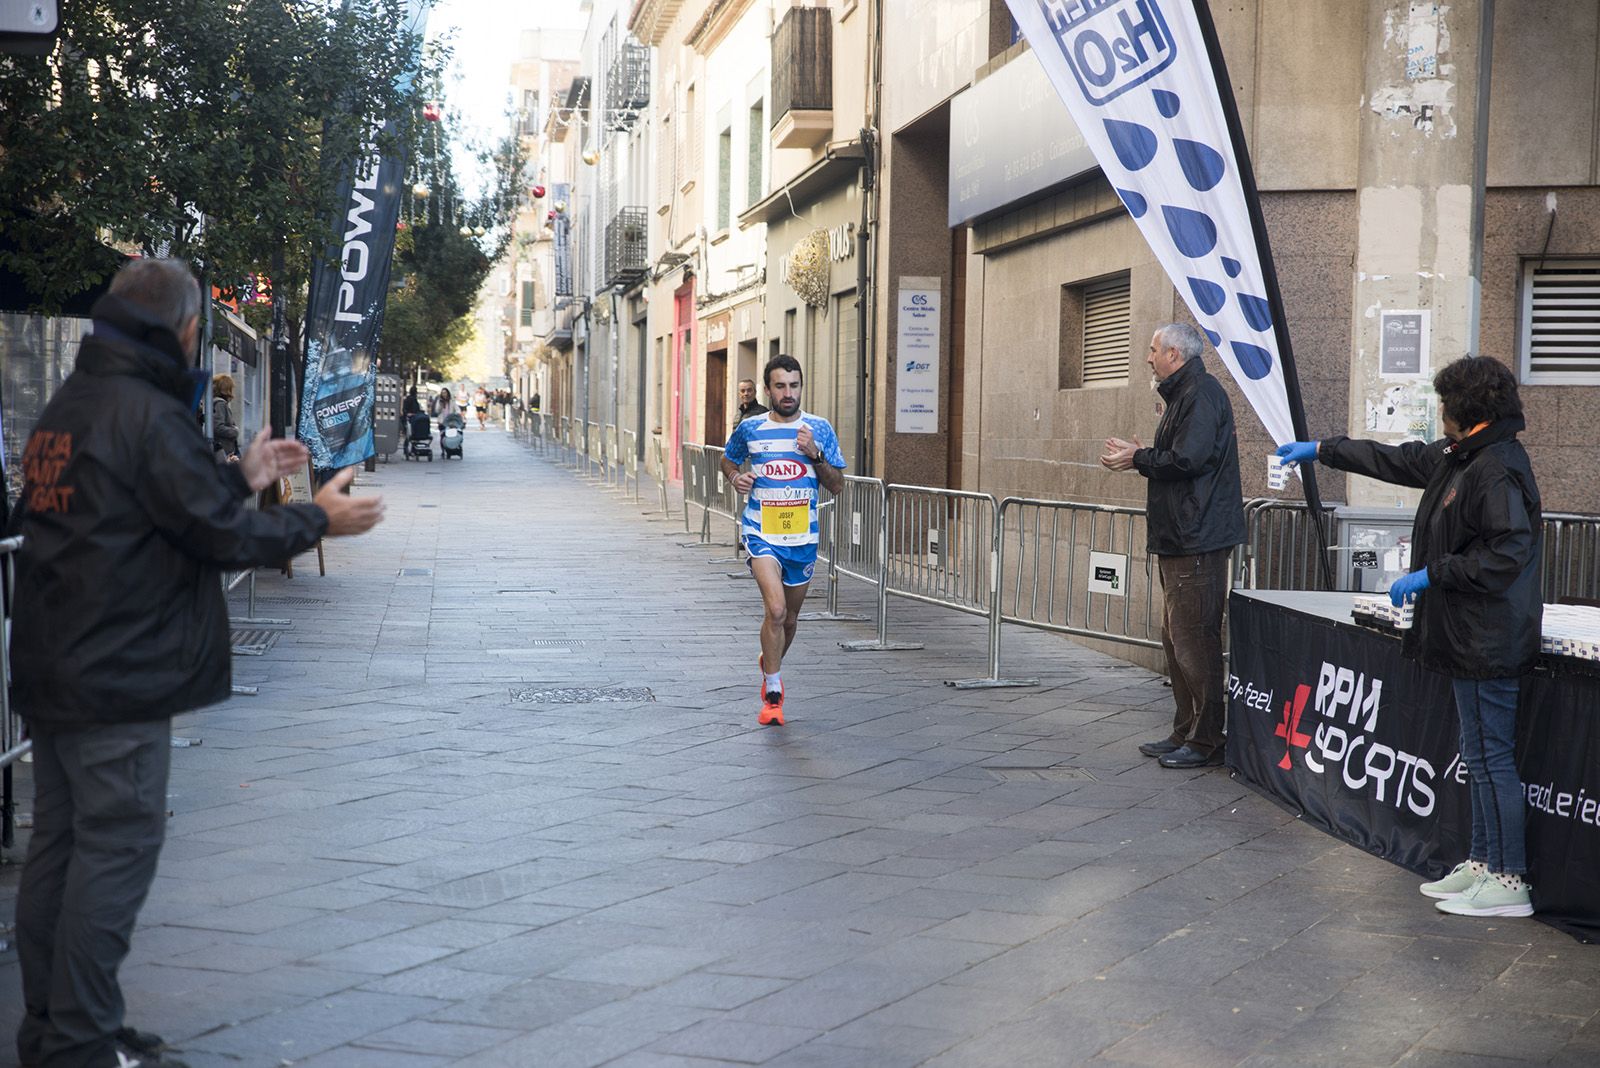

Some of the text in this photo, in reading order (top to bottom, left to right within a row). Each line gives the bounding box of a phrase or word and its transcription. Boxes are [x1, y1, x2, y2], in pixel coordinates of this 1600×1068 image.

[765, 463, 798, 476] DANI
[778, 511, 794, 519] JOSEP
[782, 520, 792, 530] 66
[1244, 682, 1273, 713] feel
[1315, 661, 1383, 733] RPM
[1305, 722, 1437, 817] SPORTS
